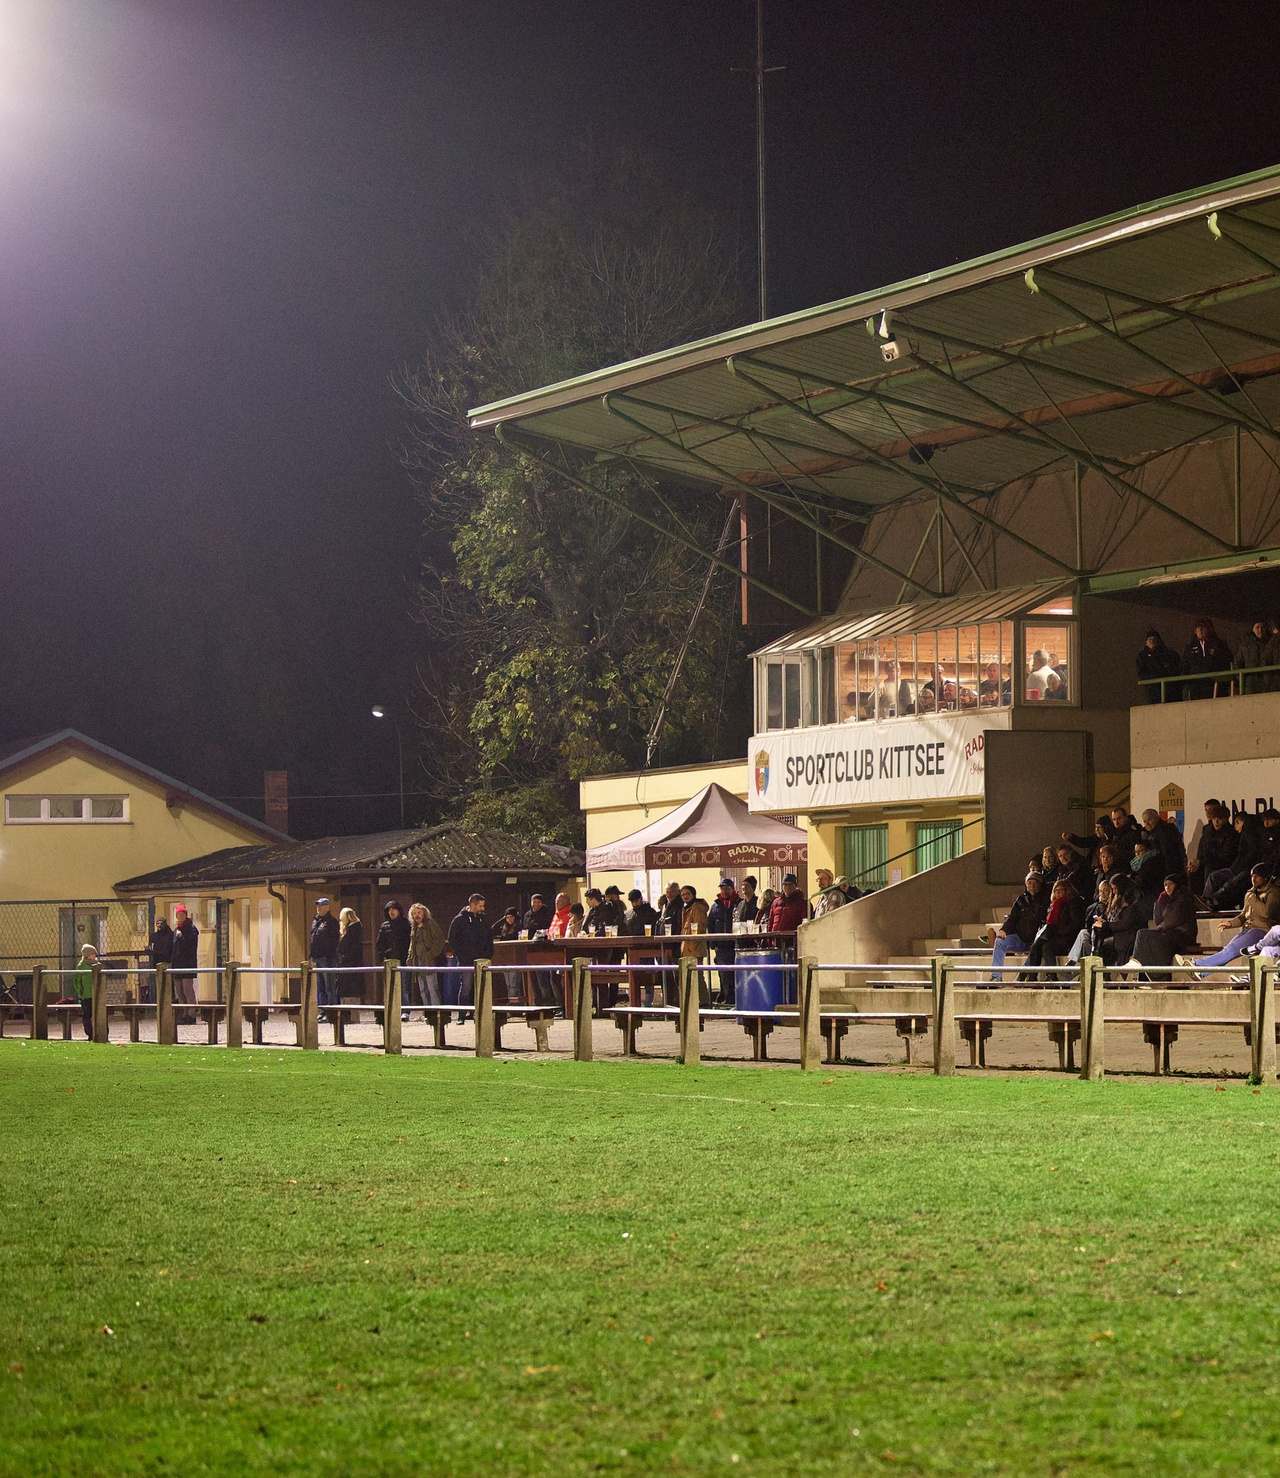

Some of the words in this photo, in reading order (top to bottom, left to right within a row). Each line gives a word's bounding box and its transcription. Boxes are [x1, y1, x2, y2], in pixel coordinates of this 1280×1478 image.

[785, 748, 874, 788] SPORTCLUB
[879, 742, 945, 779] KITTSEE
[727, 845, 767, 858] RADATZ
